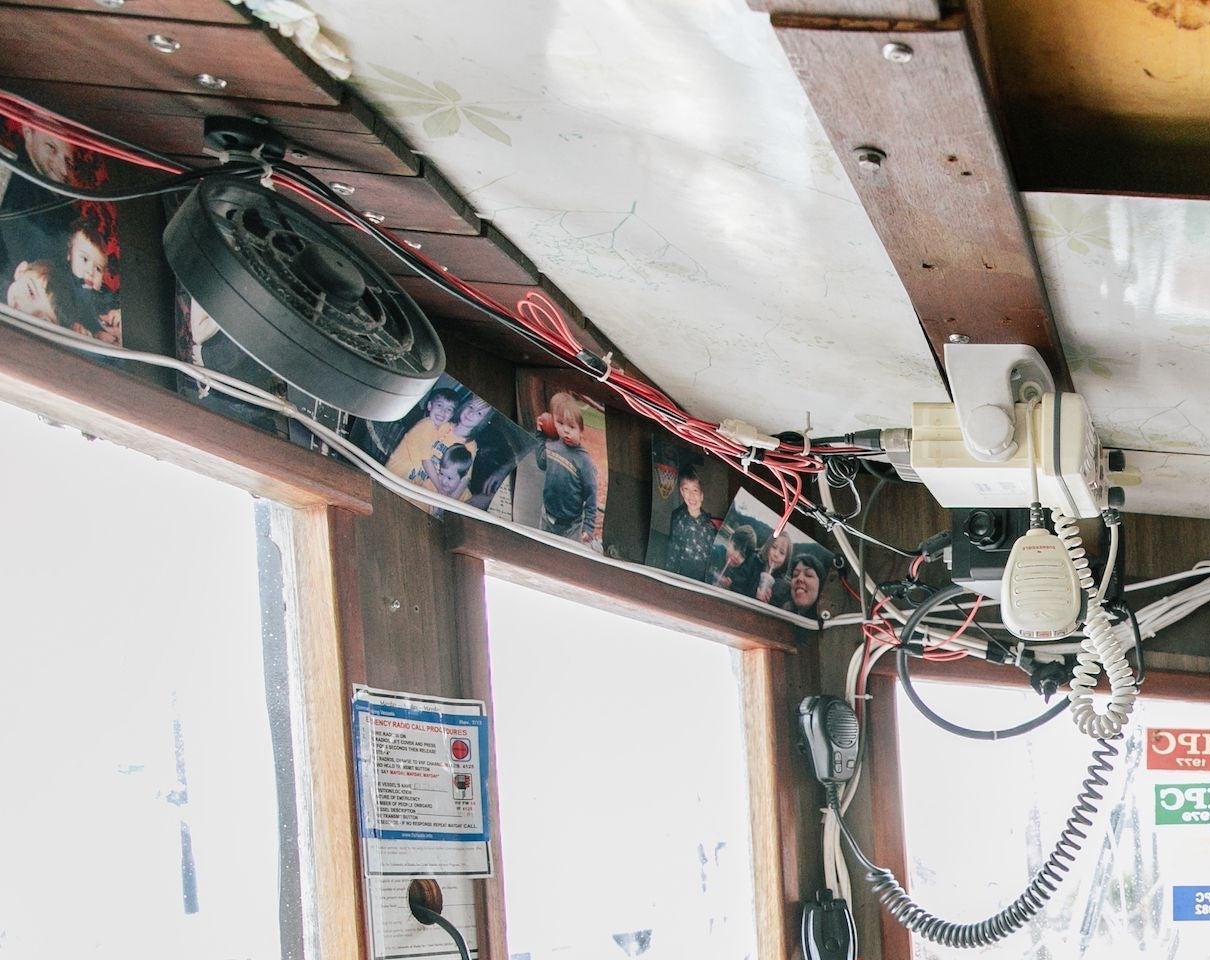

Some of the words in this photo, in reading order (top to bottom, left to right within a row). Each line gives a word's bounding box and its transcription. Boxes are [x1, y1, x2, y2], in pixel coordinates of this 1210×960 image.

[393, 721, 410, 729] RADIO
[411, 723, 425, 732] CALL
[427, 725, 467, 736] PROCDURES
